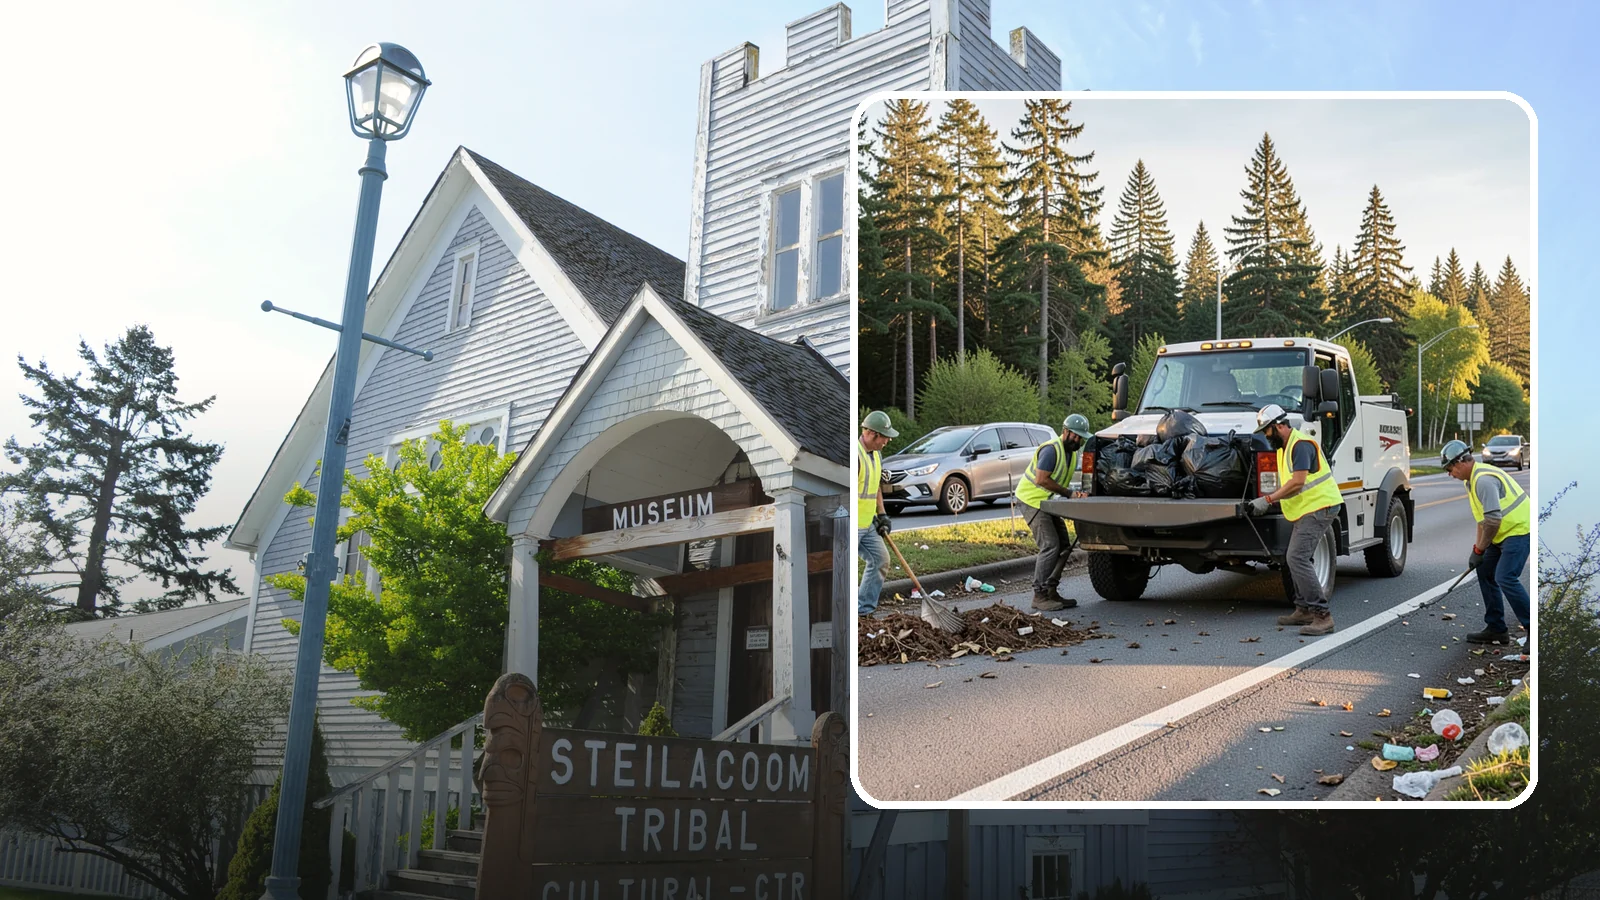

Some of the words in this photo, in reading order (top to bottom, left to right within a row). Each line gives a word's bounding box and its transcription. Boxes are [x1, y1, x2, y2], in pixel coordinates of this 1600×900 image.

[612, 491, 714, 531] MUSEUM
[550, 738, 810, 793] STEILACOOM
[614, 806, 759, 852] TRIBAL
